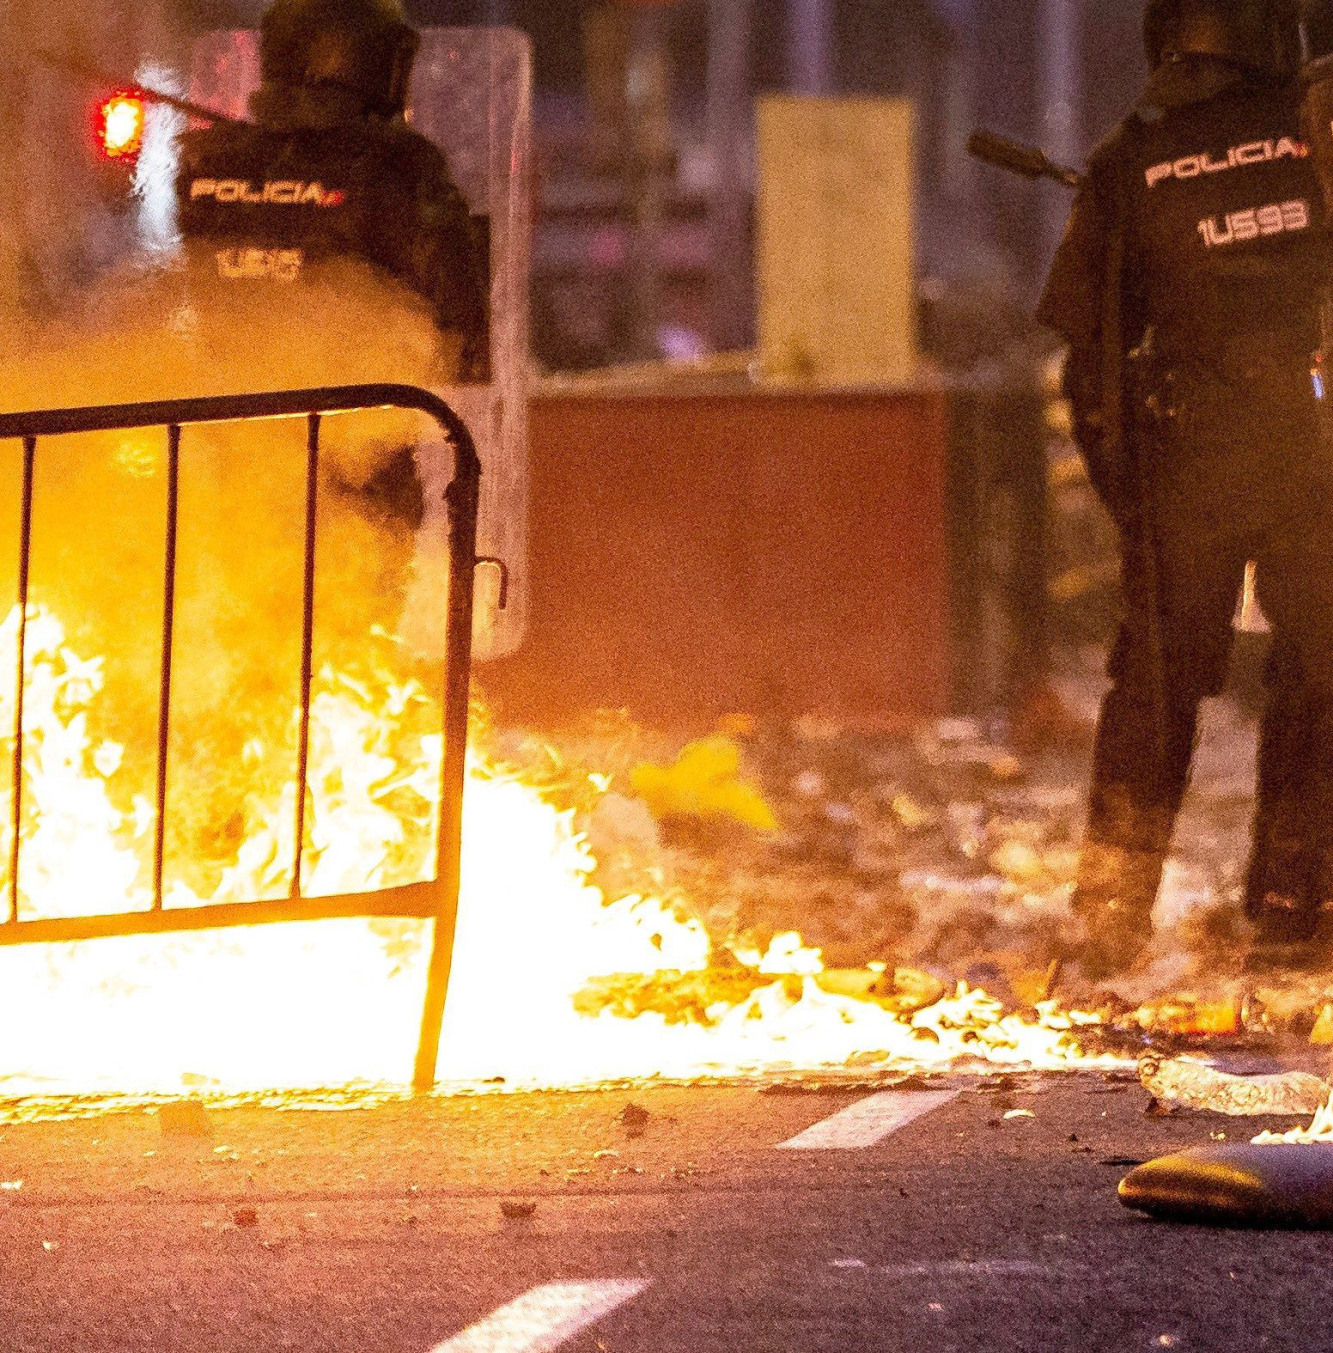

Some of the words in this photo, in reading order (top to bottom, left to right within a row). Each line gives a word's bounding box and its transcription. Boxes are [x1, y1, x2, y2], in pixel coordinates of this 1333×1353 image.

[1145, 137, 1299, 188] POLICIA
[190, 178, 325, 206] POLICIA
[1197, 198, 1308, 247] 1U593
